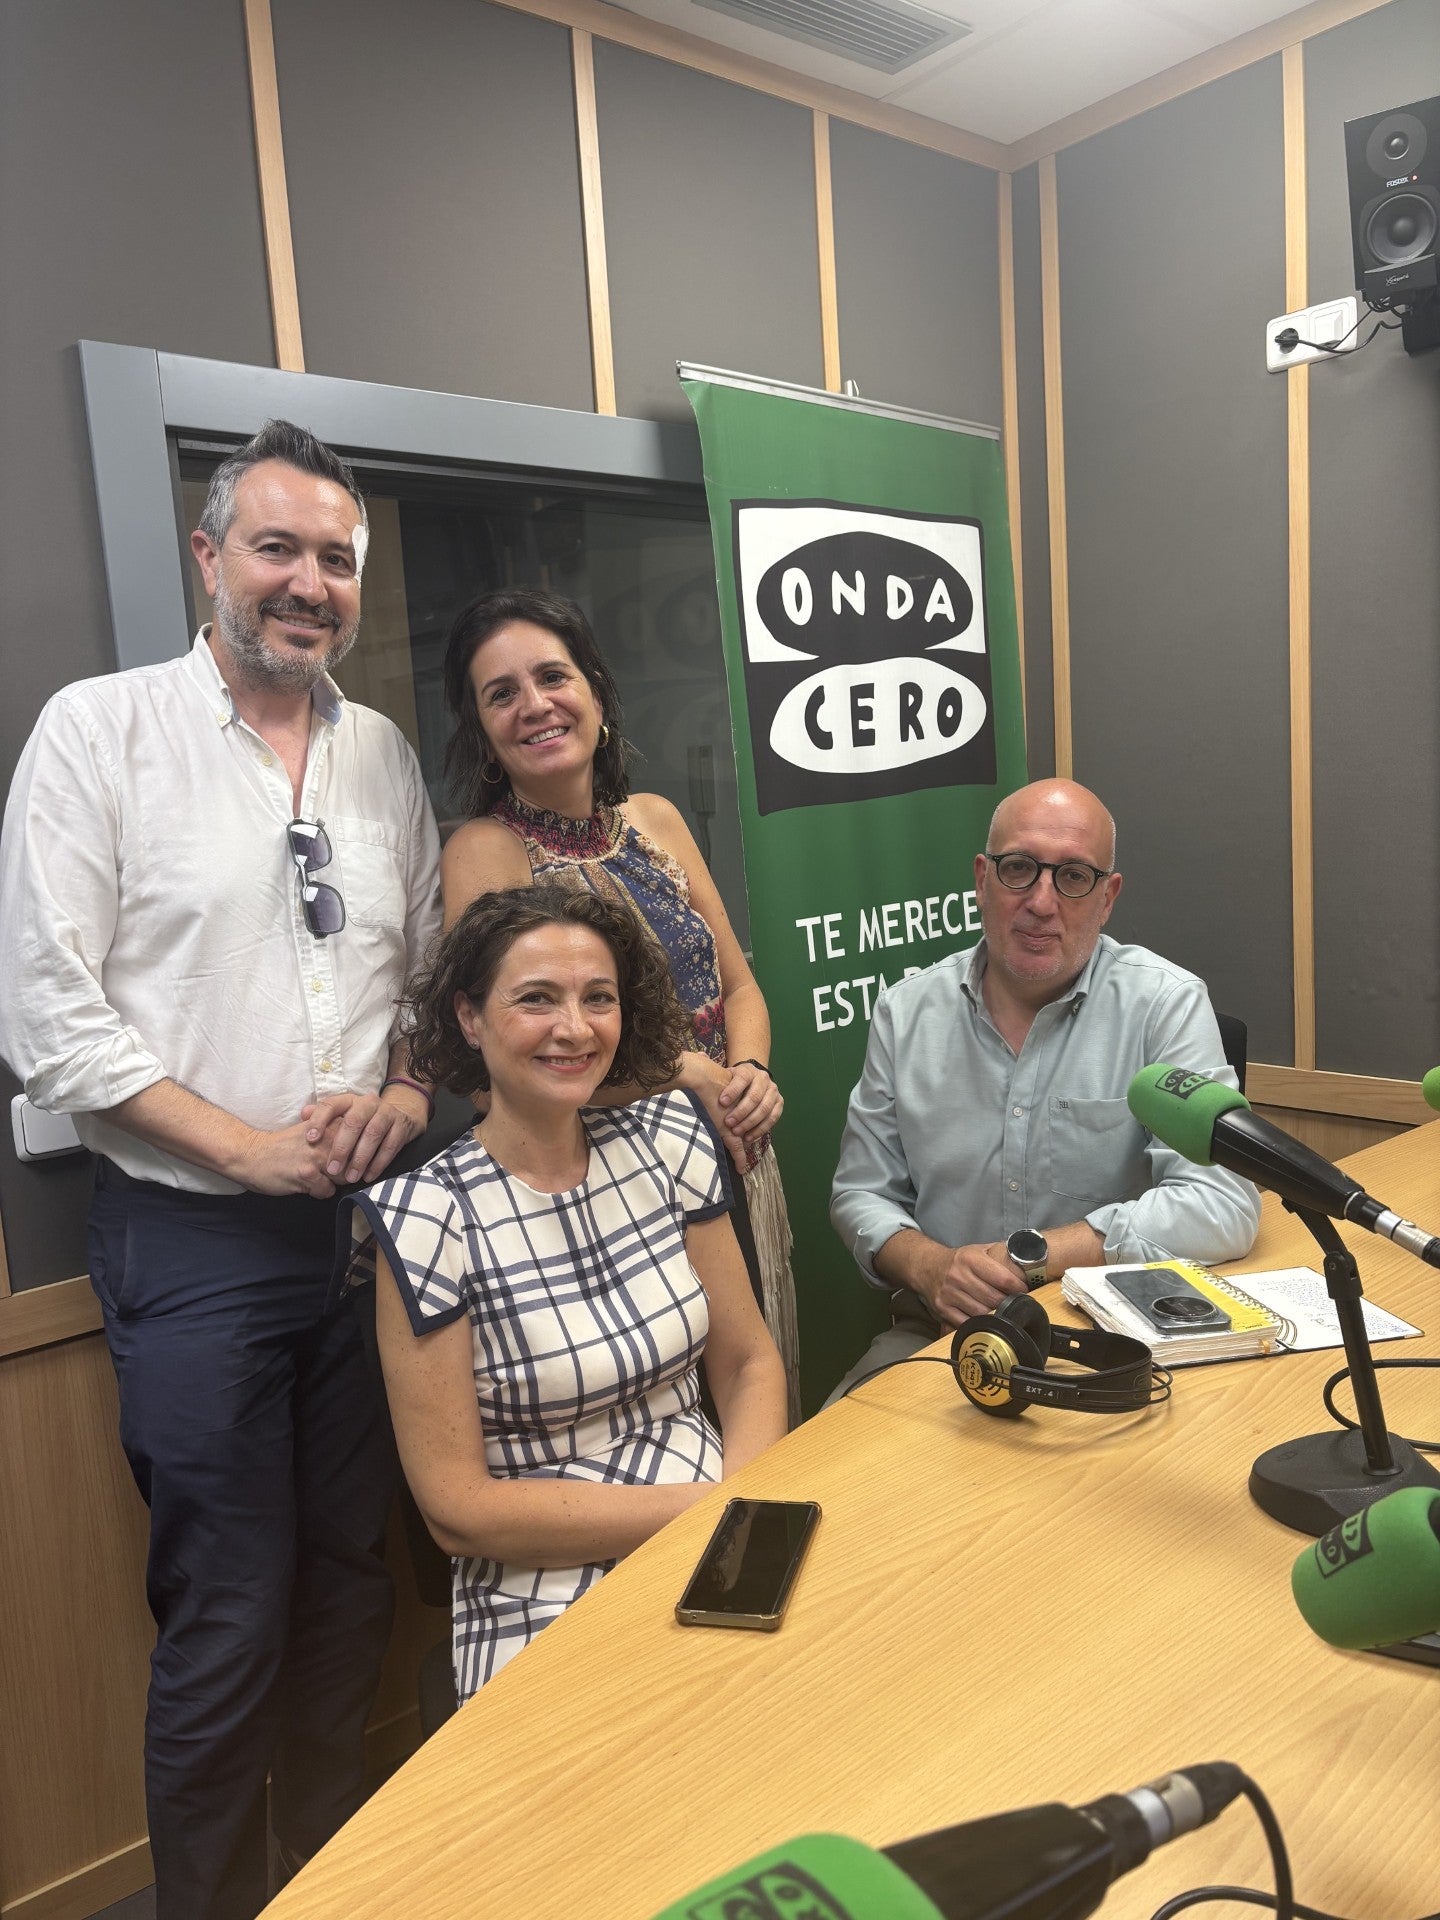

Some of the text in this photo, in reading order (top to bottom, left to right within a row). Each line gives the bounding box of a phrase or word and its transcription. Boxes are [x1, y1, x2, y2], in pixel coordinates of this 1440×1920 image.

[781, 567, 956, 626] ONDA
[804, 681, 963, 750] CERO
[795, 912, 846, 963] TE
